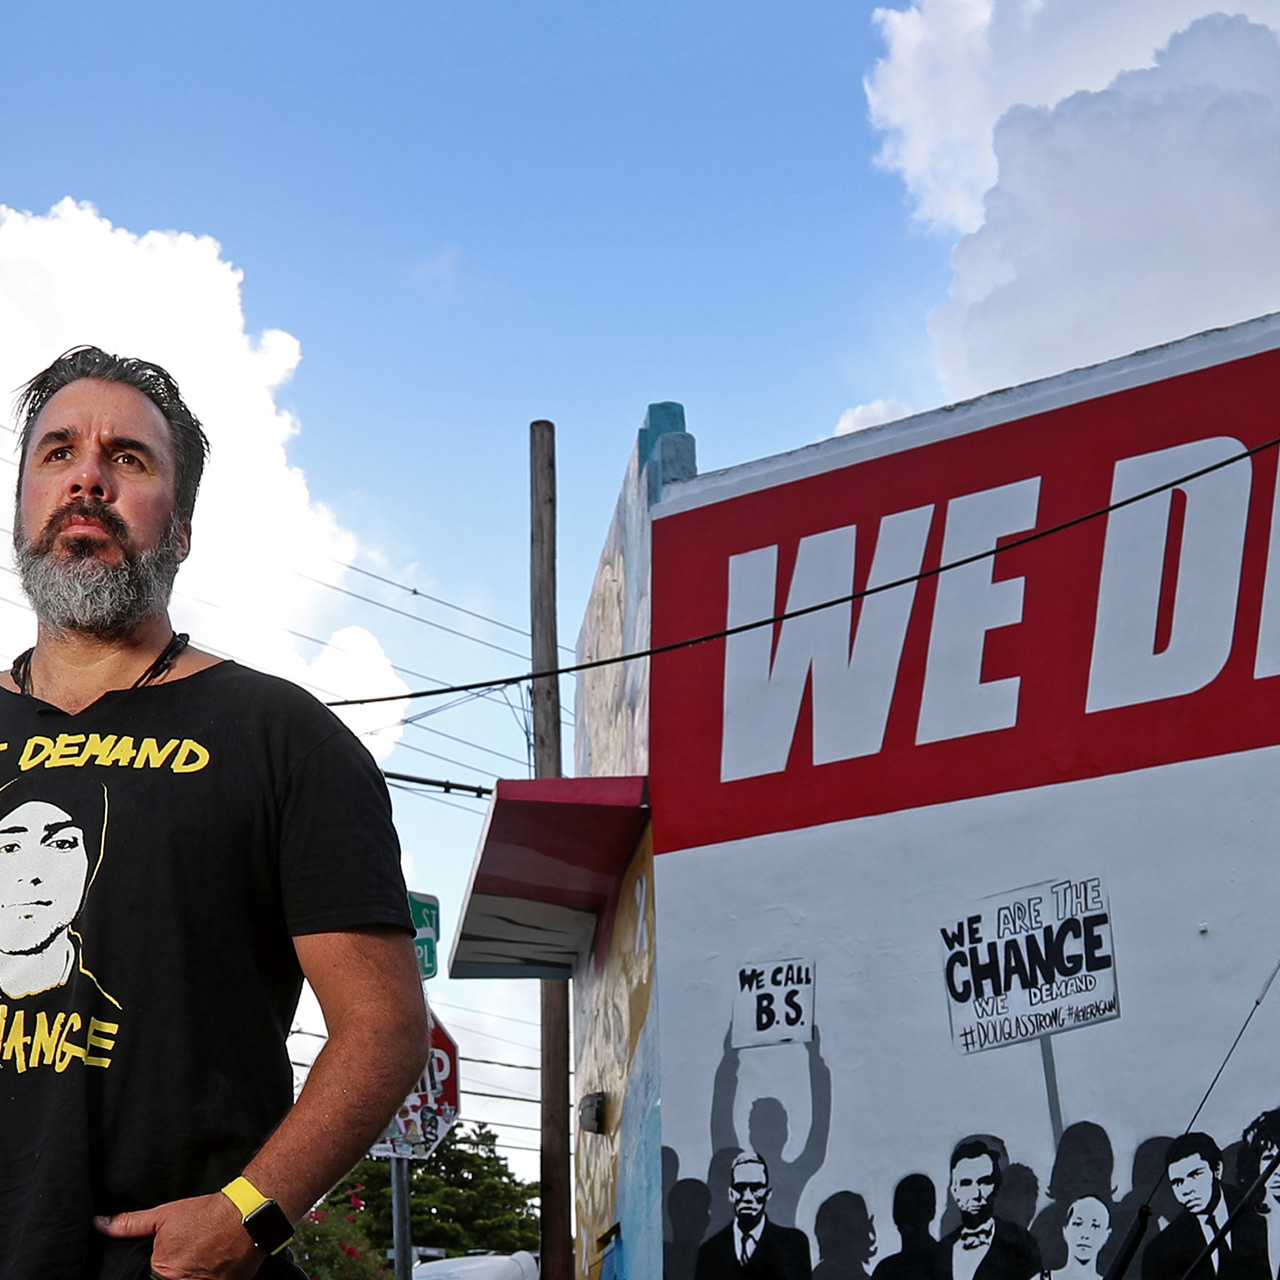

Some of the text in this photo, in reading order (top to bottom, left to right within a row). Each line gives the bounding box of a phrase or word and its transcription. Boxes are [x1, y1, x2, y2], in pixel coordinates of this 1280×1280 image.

[721, 476, 1041, 782] WE
[18, 733, 210, 773] DEMAND
[940, 878, 1103, 951] WE ARE THE
[739, 964, 812, 992] WE CALL
[946, 913, 1112, 1003] CHANGE
[973, 974, 1097, 1019] WE DEMAND
[959, 1006, 1066, 1052] #DOUGLASSTRONG
